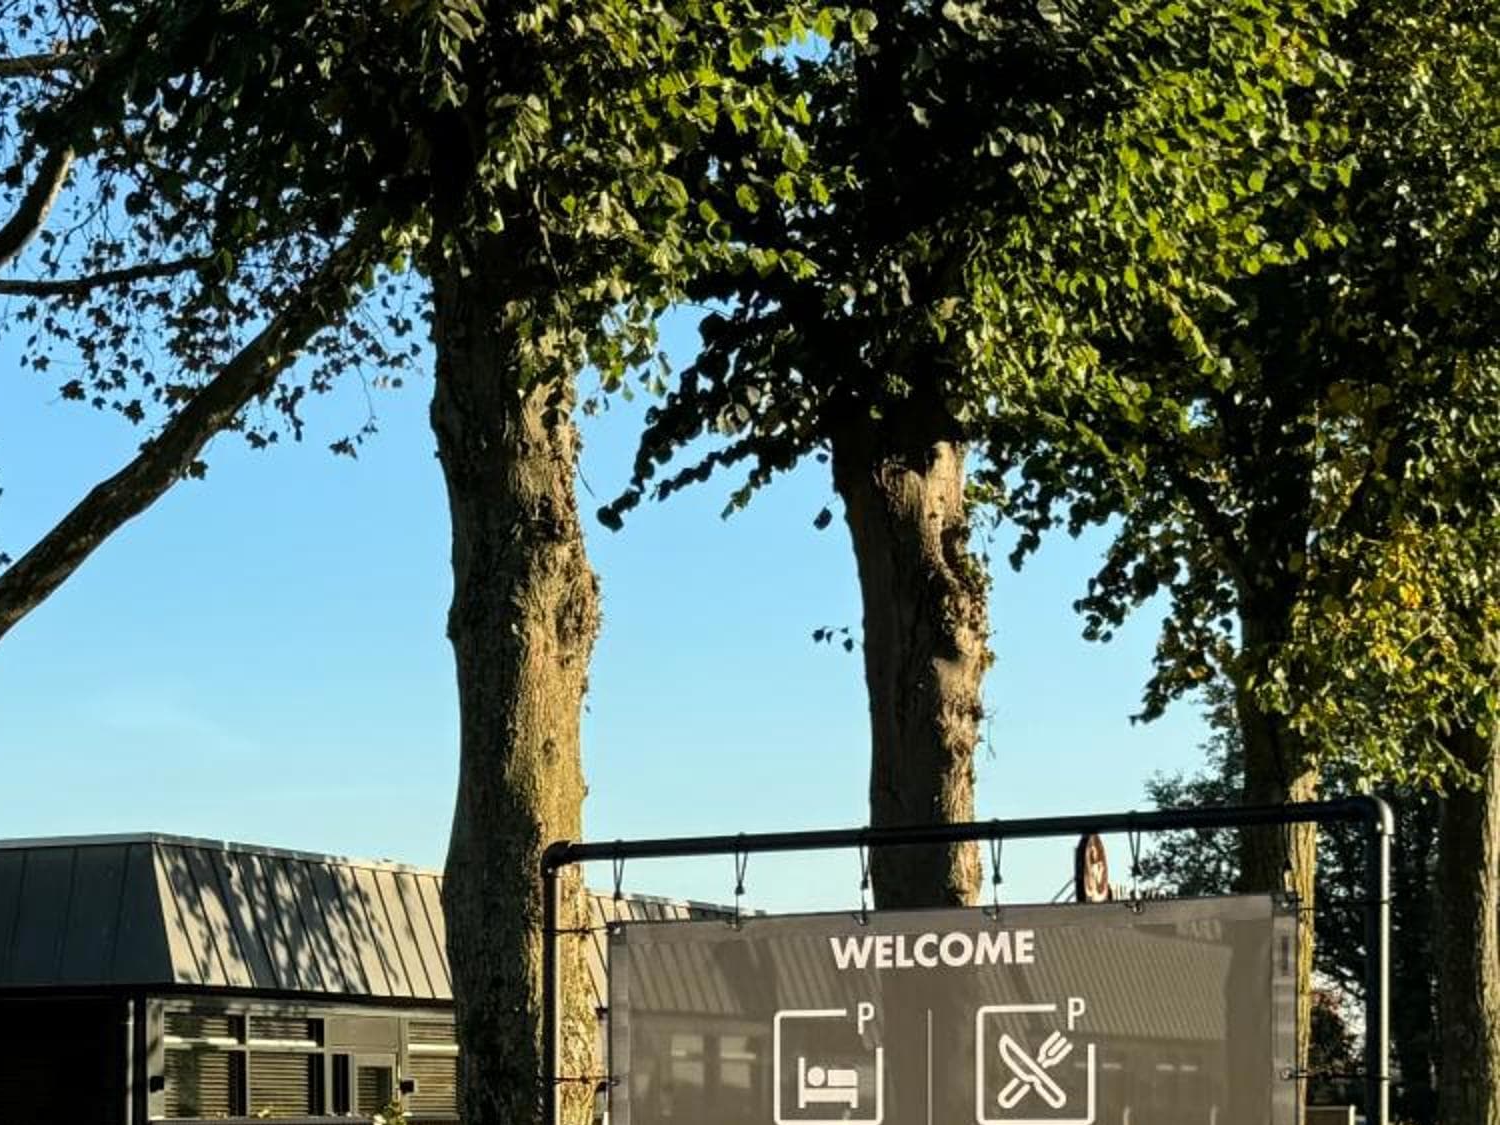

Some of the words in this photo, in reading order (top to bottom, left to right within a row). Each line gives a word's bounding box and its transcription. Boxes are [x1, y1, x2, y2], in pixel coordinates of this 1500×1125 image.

[829, 929, 1036, 970] WELCOME
[856, 1001, 875, 1035] P
[1066, 996, 1086, 1031] P
